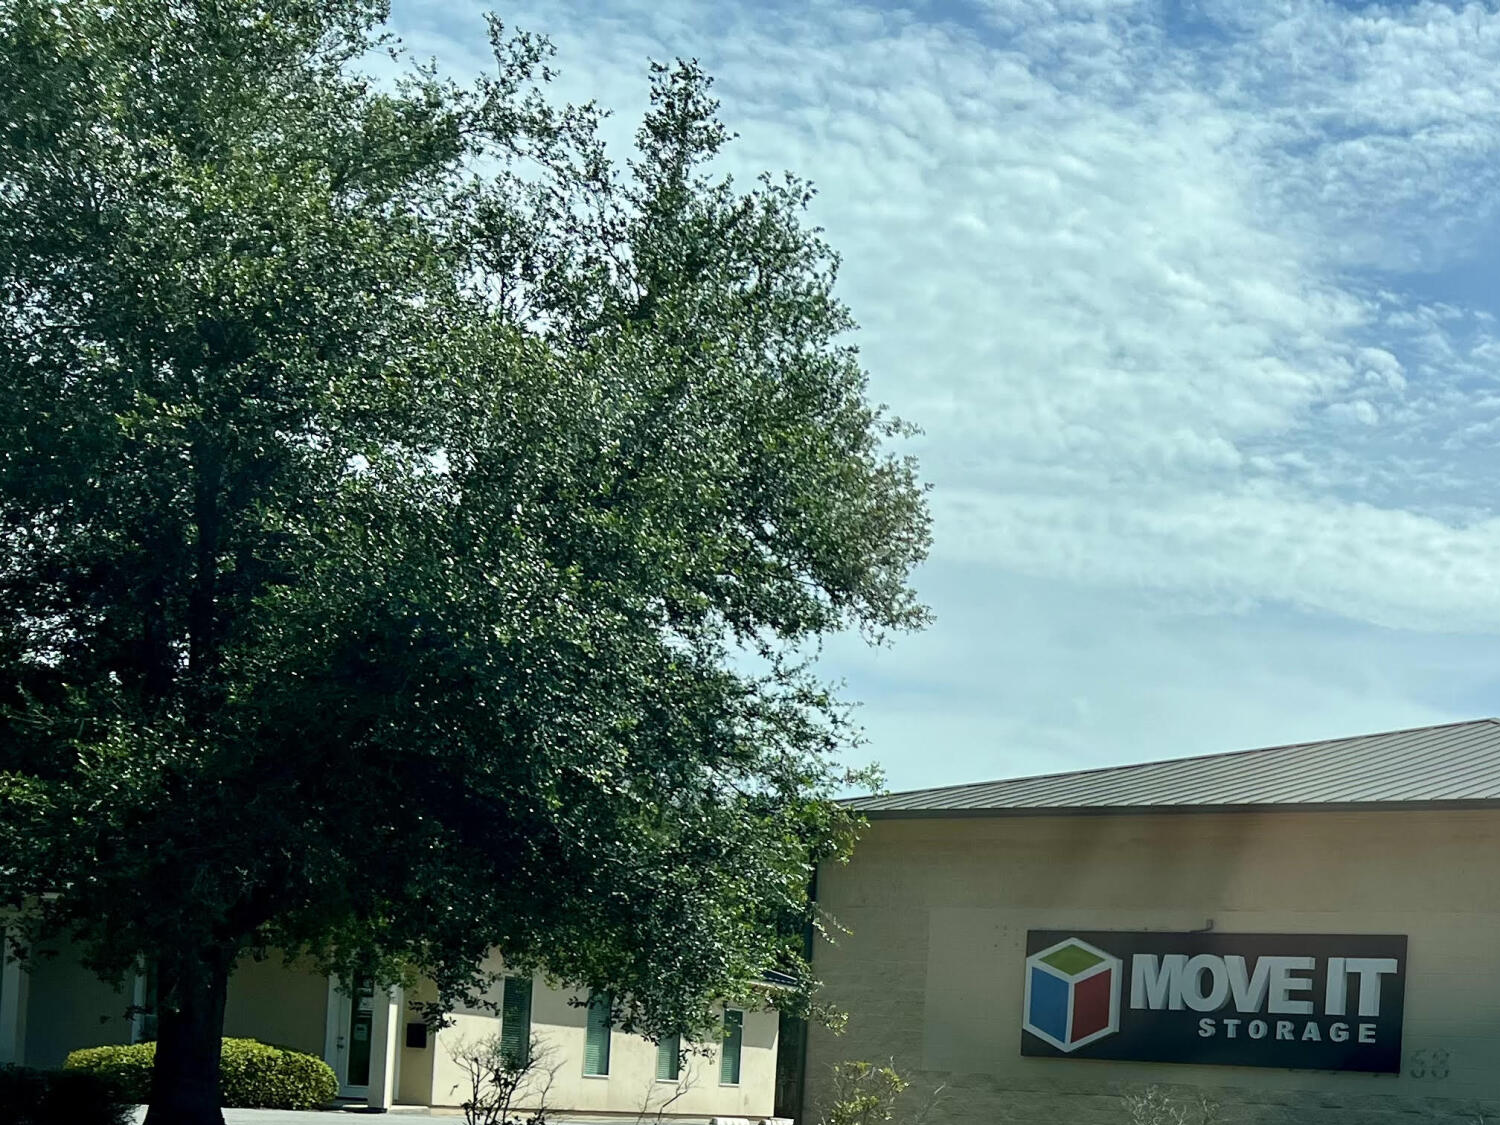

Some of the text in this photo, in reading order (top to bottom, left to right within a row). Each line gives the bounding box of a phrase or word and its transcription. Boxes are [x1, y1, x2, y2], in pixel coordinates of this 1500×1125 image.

[1129, 953, 1398, 1017] MOVE IT
[1197, 1018, 1377, 1045] STORAGE
